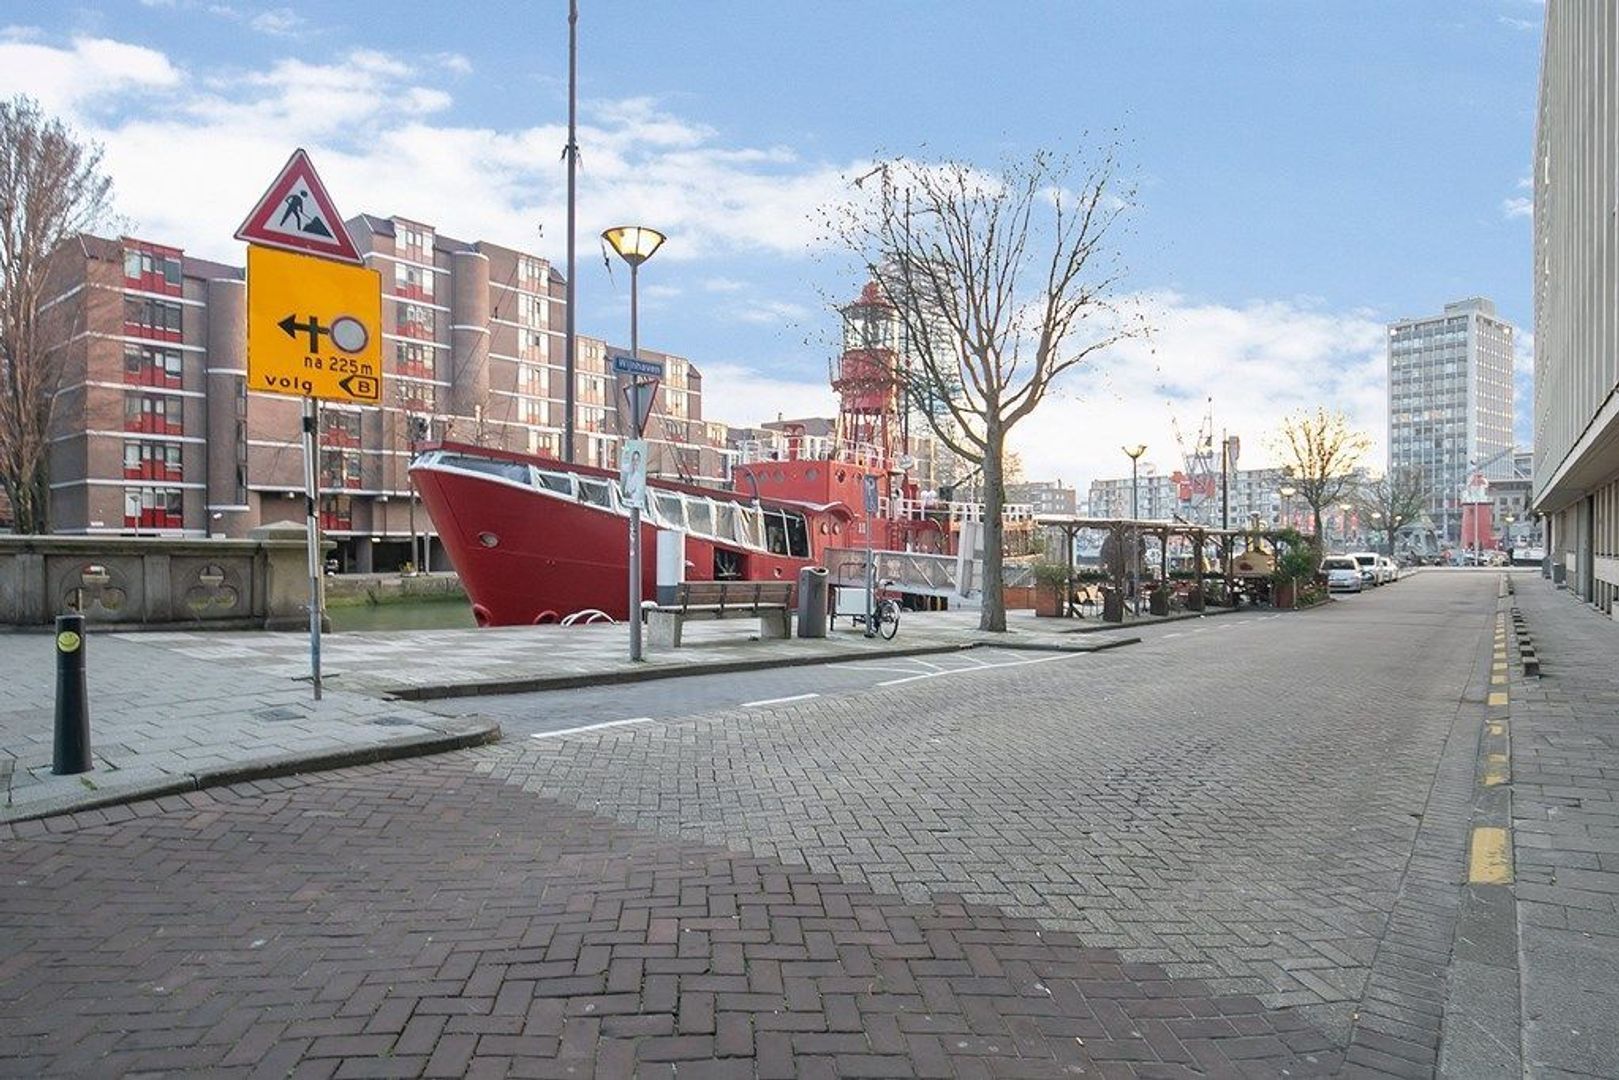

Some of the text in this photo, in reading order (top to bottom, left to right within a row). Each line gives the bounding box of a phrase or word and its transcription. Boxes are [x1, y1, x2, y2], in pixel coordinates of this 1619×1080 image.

[304, 356, 373, 375] na 225m
[358, 380, 370, 393] B
[866, 478, 876, 496] P
